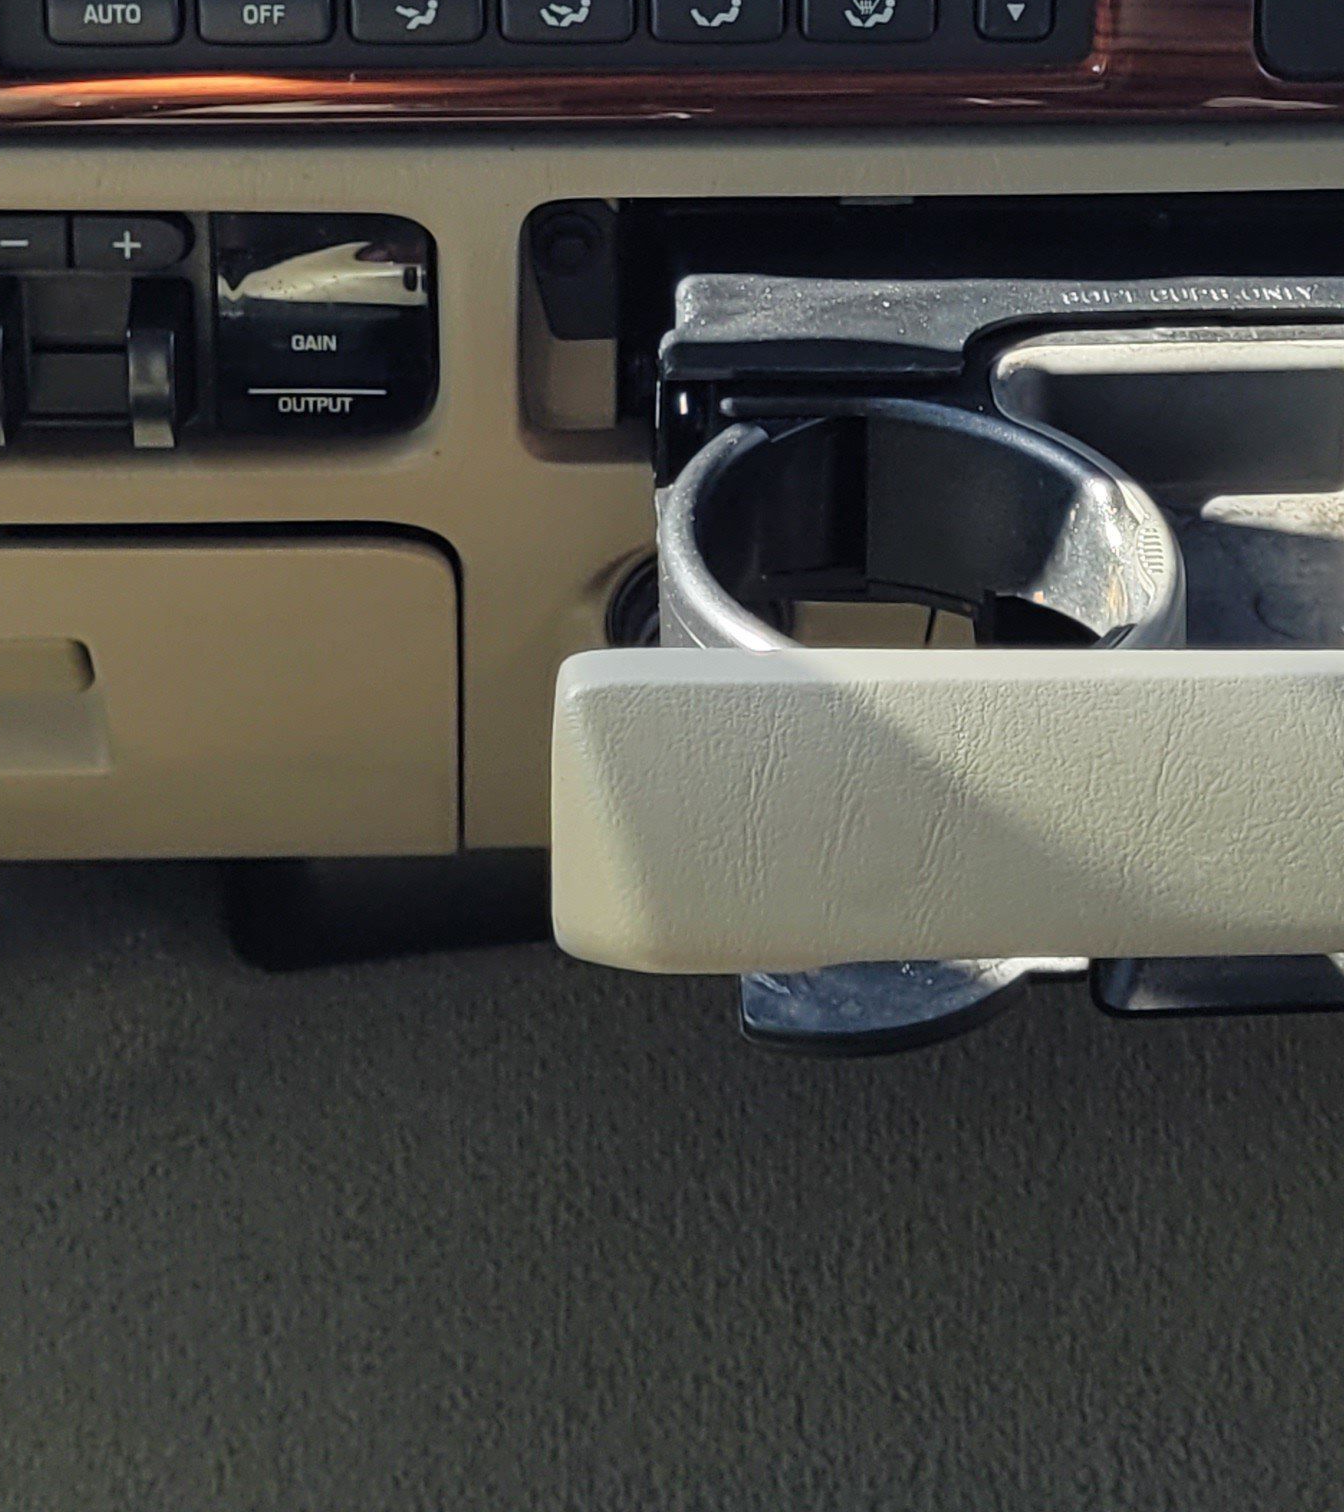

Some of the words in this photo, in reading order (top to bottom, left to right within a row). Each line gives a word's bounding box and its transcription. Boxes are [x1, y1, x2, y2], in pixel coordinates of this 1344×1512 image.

[83, 3, 141, 24] AUTO
[243, 4, 285, 25] OFF
[291, 334, 337, 351] GAIN
[278, 396, 354, 413] OUTPUT
